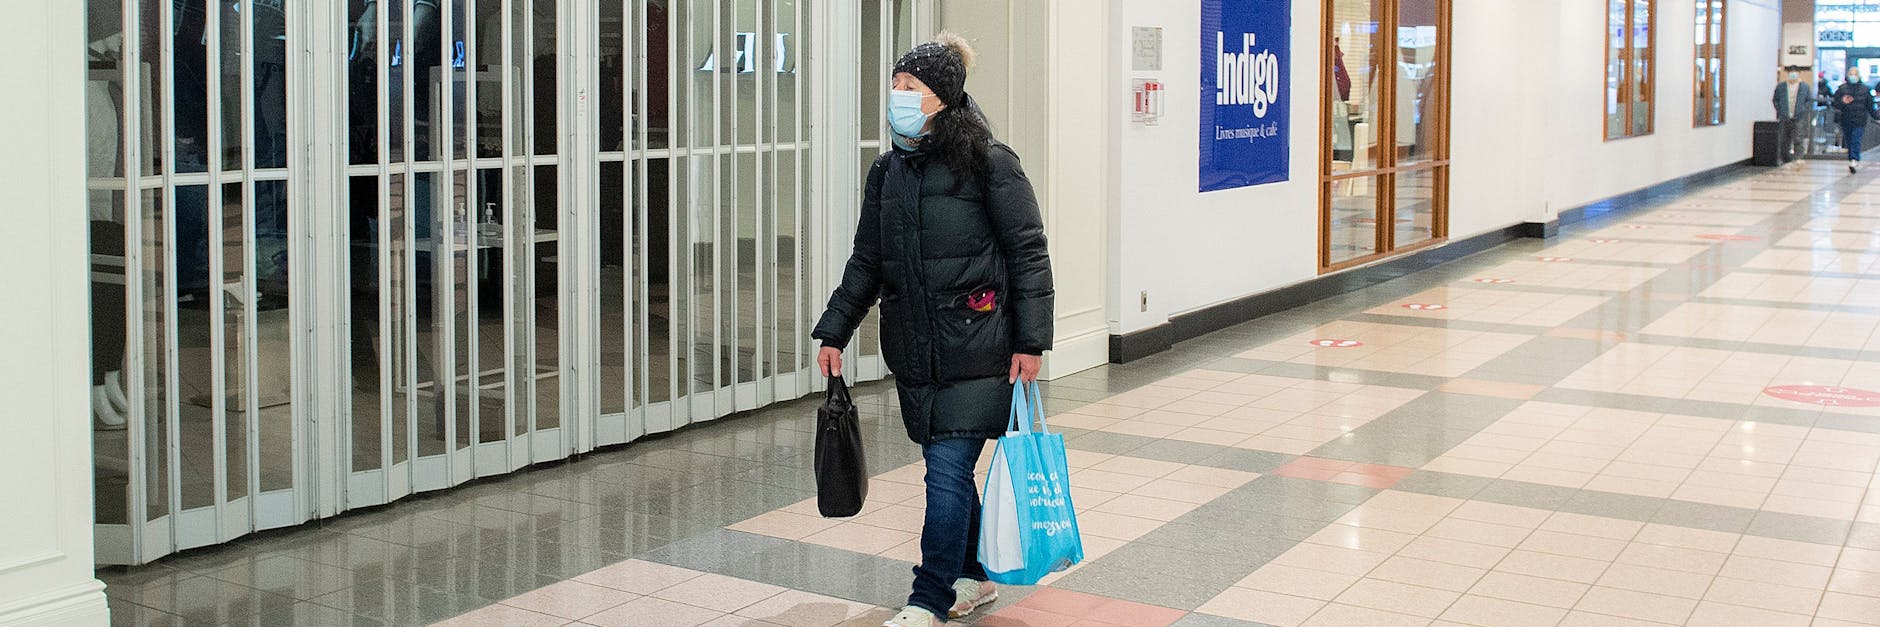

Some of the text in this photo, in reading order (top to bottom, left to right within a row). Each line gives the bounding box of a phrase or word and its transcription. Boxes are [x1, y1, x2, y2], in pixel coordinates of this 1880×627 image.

[1215, 125, 1235, 140] Livres
[1235, 124, 1259, 143] musique
[1259, 123, 1266, 139] &
